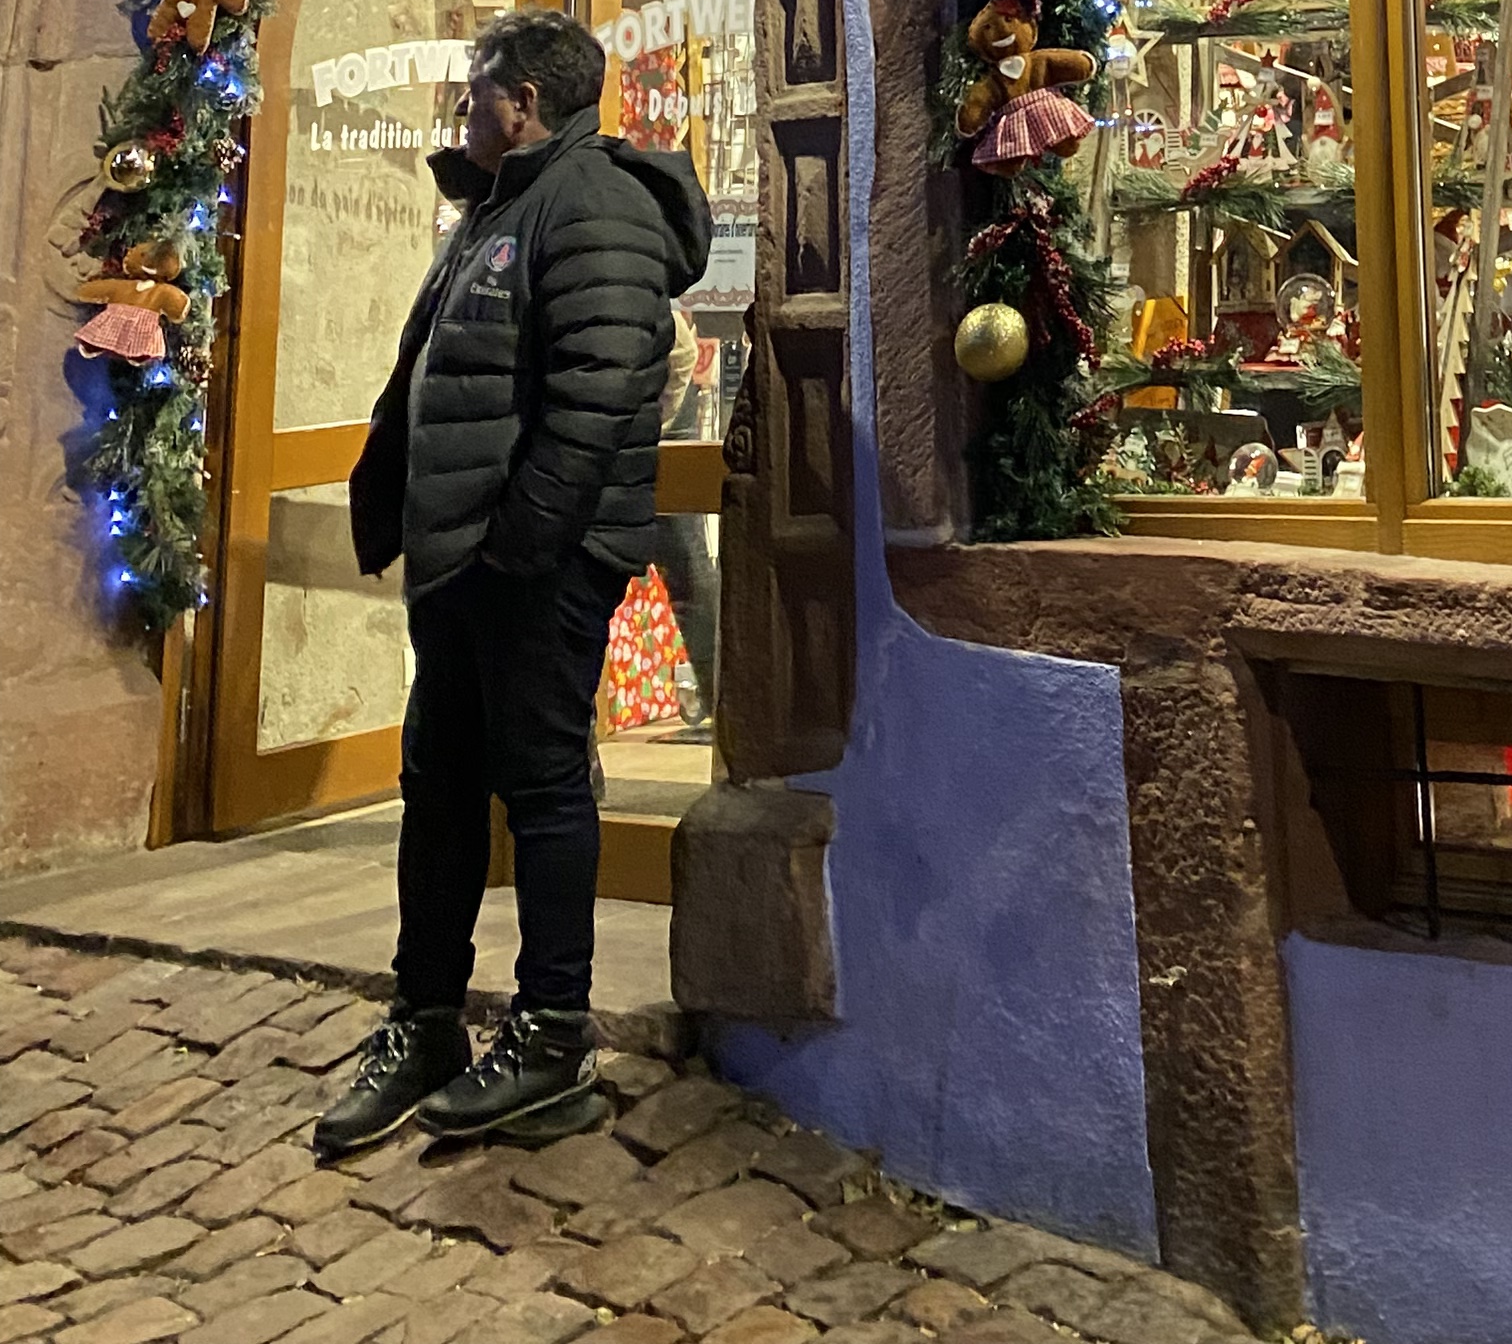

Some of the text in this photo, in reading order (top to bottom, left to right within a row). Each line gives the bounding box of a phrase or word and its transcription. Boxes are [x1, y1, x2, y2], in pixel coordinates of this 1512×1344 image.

[311, 39, 475, 108] FORTWE
[311, 122, 332, 151] La
[341, 119, 423, 150] tradition
[431, 118, 453, 148] du
